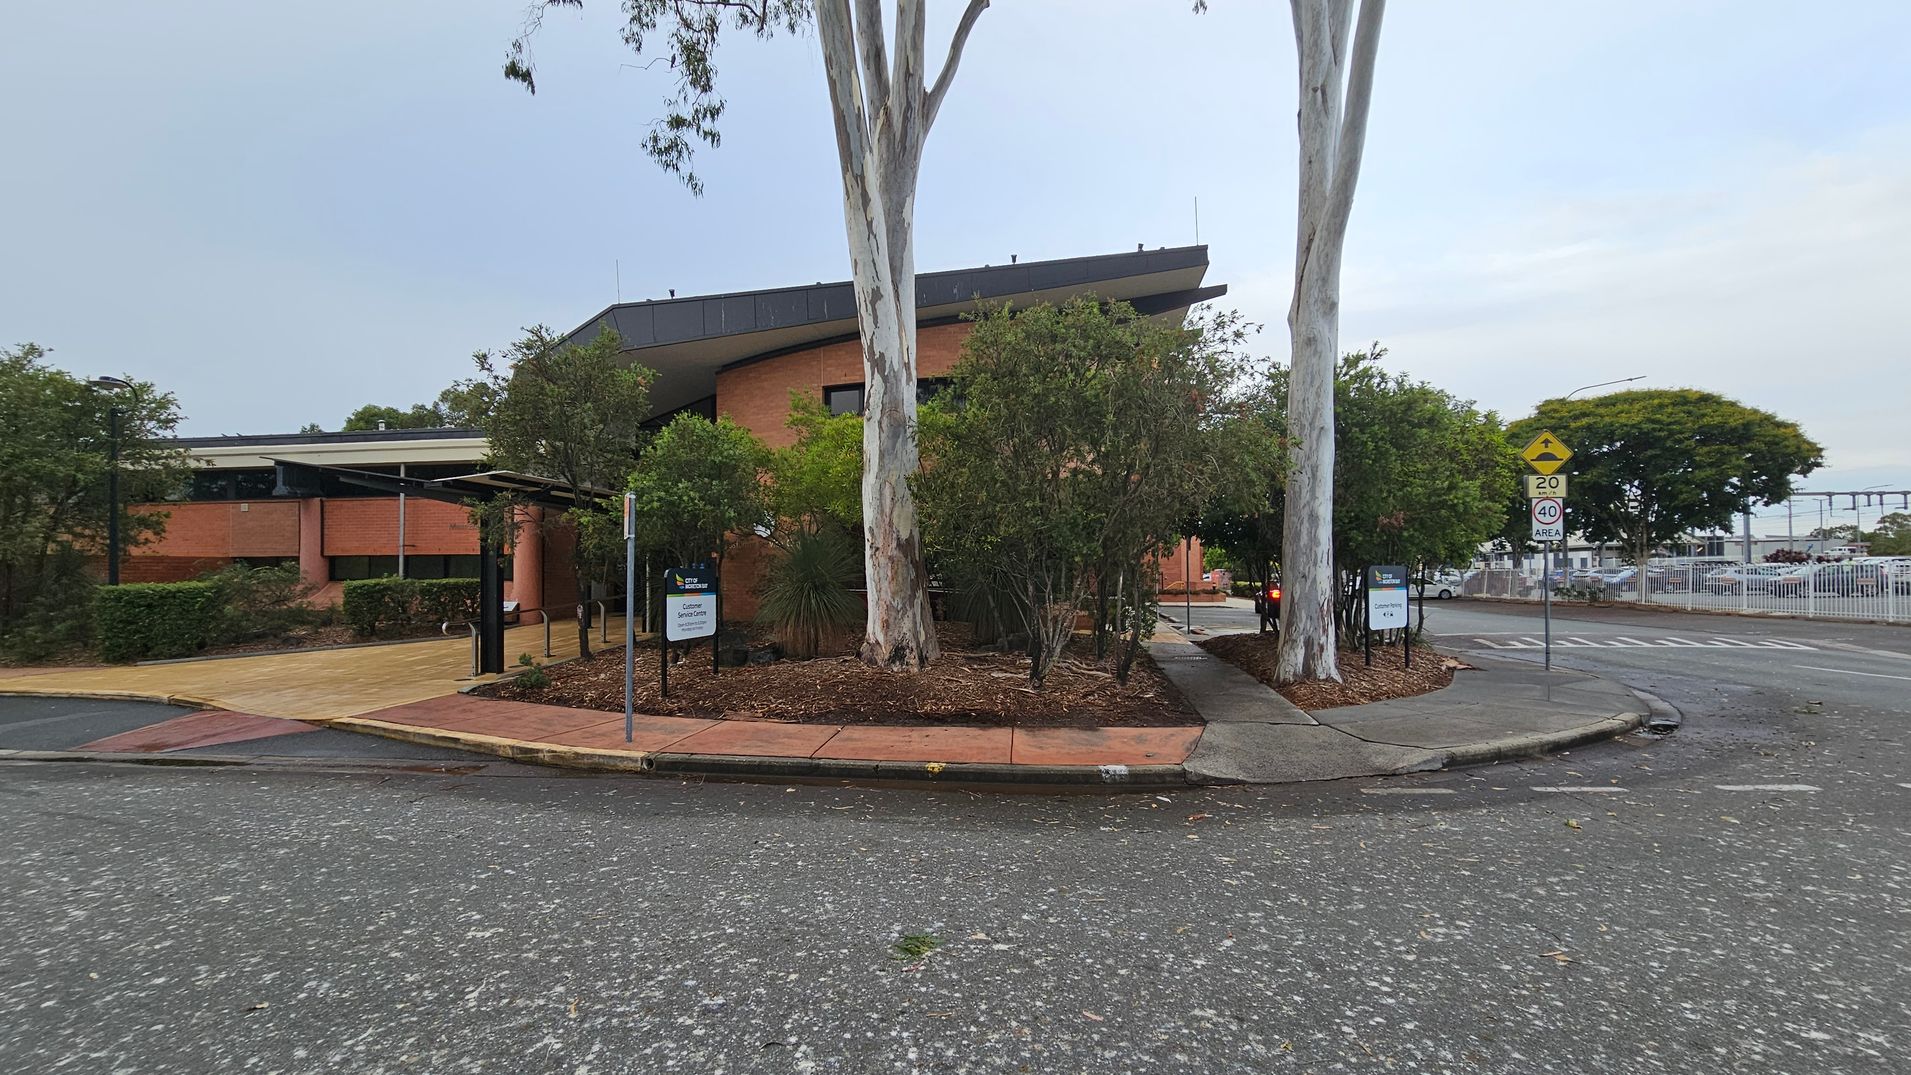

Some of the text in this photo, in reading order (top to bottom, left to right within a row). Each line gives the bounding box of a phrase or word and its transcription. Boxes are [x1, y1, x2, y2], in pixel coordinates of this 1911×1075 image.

[1536, 477, 1559, 489] 20
[1538, 506, 1557, 517] 40
[1535, 529, 1561, 537] AREA
